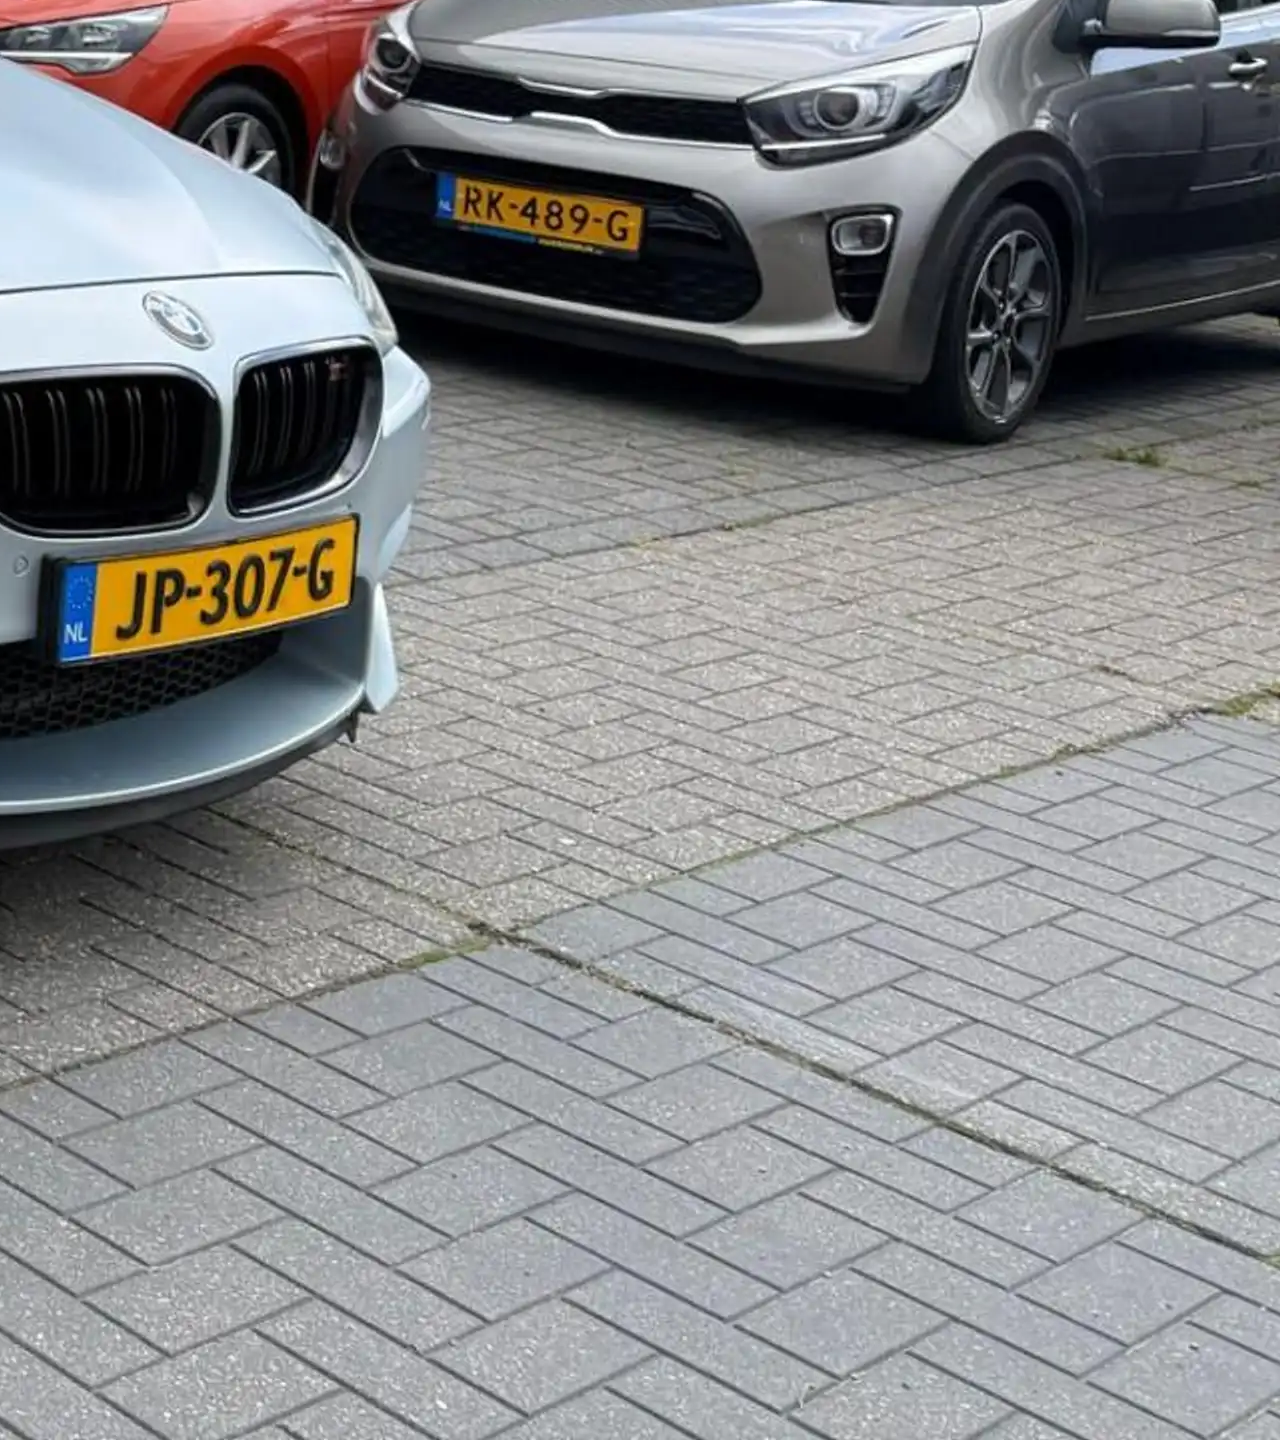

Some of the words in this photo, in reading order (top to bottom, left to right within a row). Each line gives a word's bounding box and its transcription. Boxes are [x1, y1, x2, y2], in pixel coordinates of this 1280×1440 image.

[463, 185, 630, 243] RK-489-G
[115, 537, 336, 641] JP-307-G
[63, 621, 89, 645] NL
